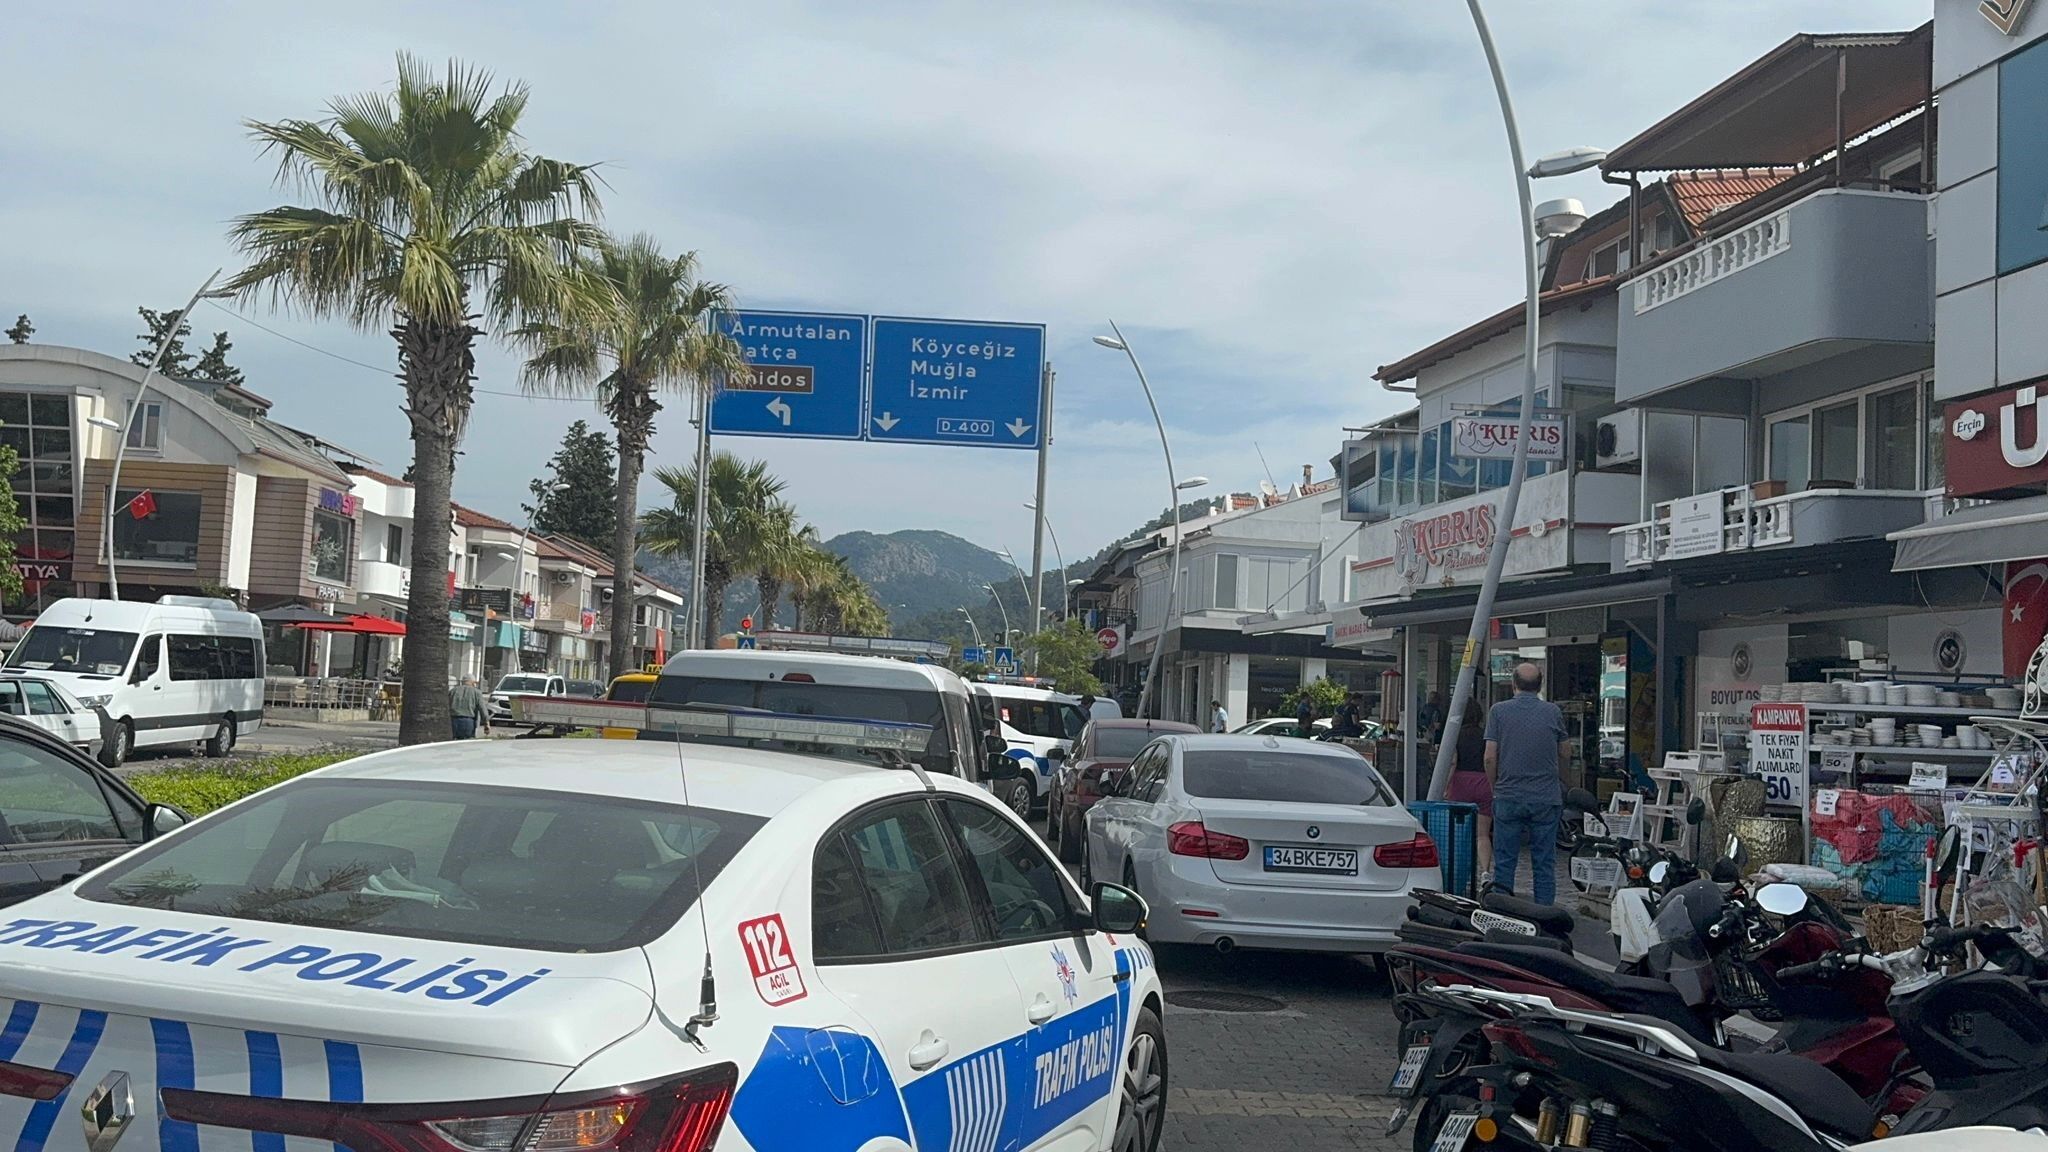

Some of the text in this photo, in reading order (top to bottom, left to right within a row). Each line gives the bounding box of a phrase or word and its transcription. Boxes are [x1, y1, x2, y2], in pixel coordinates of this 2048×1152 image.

[731, 321, 850, 341] Armutalan
[739, 343, 797, 361] atça
[911, 337, 1016, 360] Köyceğiz
[728, 370, 807, 388] Knidos
[911, 359, 977, 380] Muğla
[910, 379, 968, 400] İzmir
[1957, 419, 1981, 434] Erçin
[2000, 385, 2048, 468] Ü
[1413, 503, 1490, 565] KIBRIS
[10, 564, 59, 578] ATYA
[650, 664, 663, 675] TA
[1711, 691, 1743, 704] BOYUT
[1757, 709, 1802, 725] KAMPANYA
[1760, 734, 1777, 746] TEK
[1826, 759, 1842, 767] 50
[1766, 776, 1791, 800] 50
[743, 919, 793, 974] 112
[0, 918, 553, 1007] TRAFİK POLİSİ
[1033, 1012, 1114, 1110] TRAFİK POLİSİ
